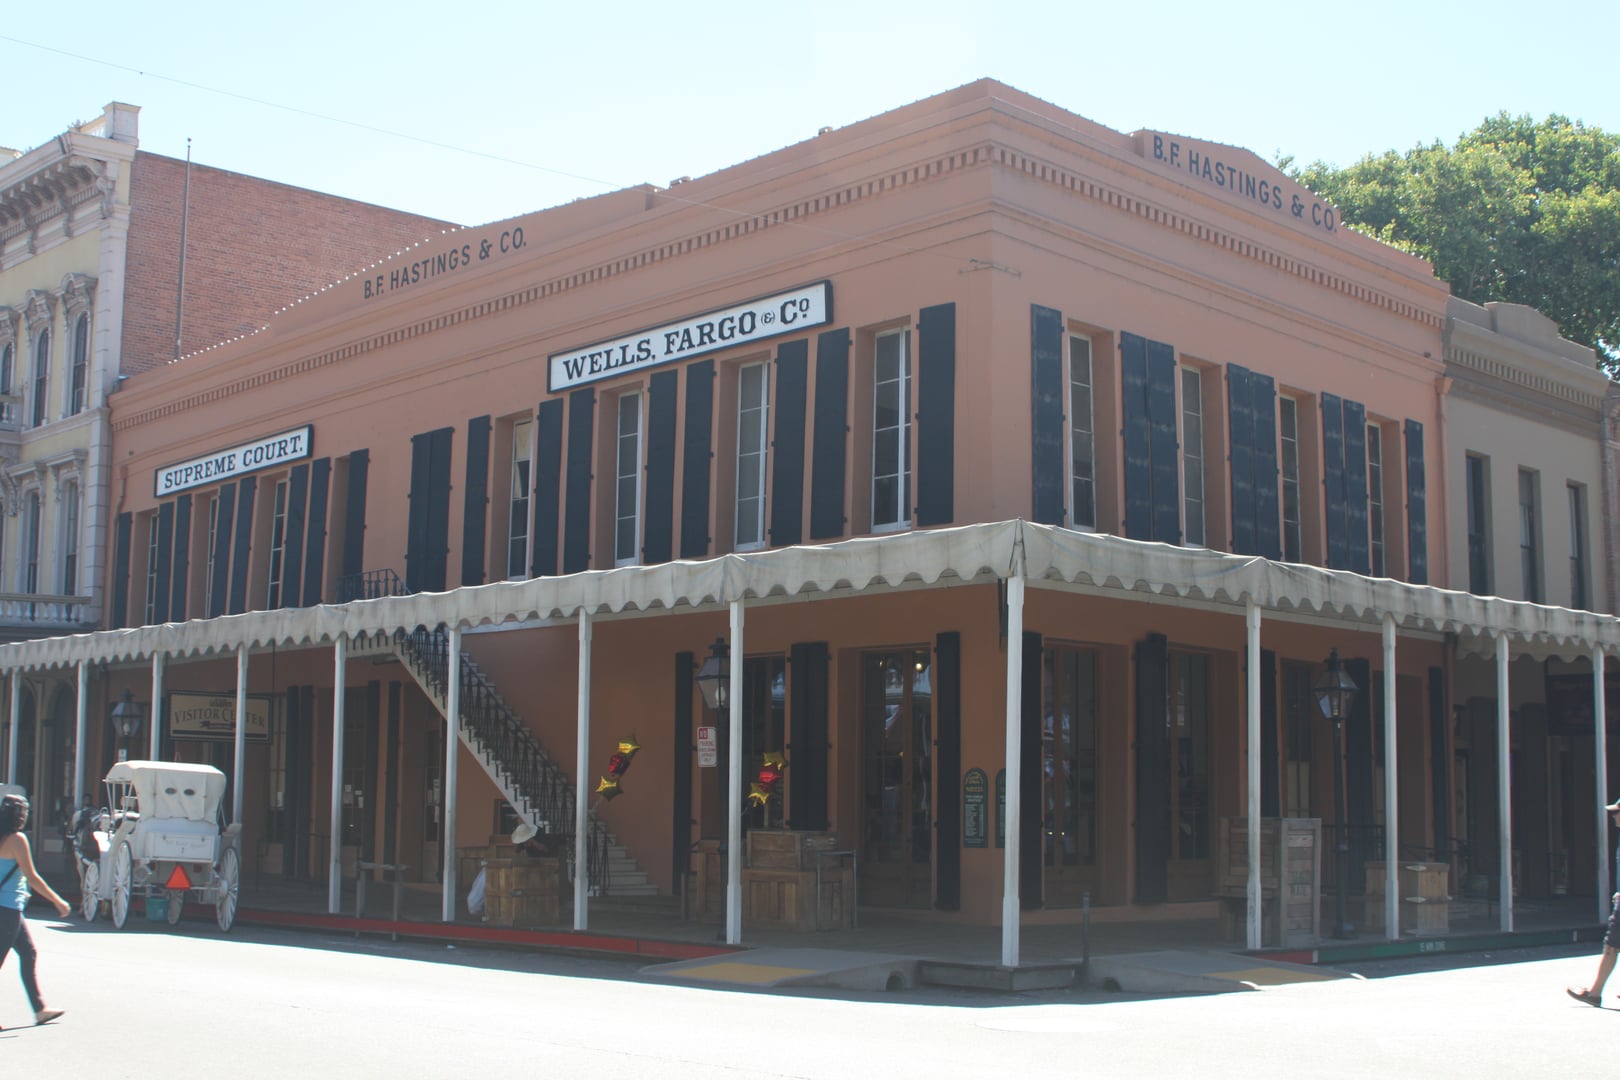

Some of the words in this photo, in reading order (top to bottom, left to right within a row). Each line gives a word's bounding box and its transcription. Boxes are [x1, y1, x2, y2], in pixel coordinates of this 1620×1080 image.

[1153, 134, 1181, 168] B.F.
[1188, 149, 1283, 210] HASTINGS
[1290, 194, 1305, 218] &
[1312, 202, 1338, 233] CO.
[363, 275, 385, 299] B.F.
[389, 244, 471, 291] HASTINGS
[478, 238, 493, 261] &
[500, 227, 527, 254] CO.
[663, 310, 757, 355] FARGO
[164, 453, 236, 489] SUPREME
[242, 434, 304, 467] COURT.
[174, 708, 220, 725] VISITOR
[221, 708, 265, 728] CETER
